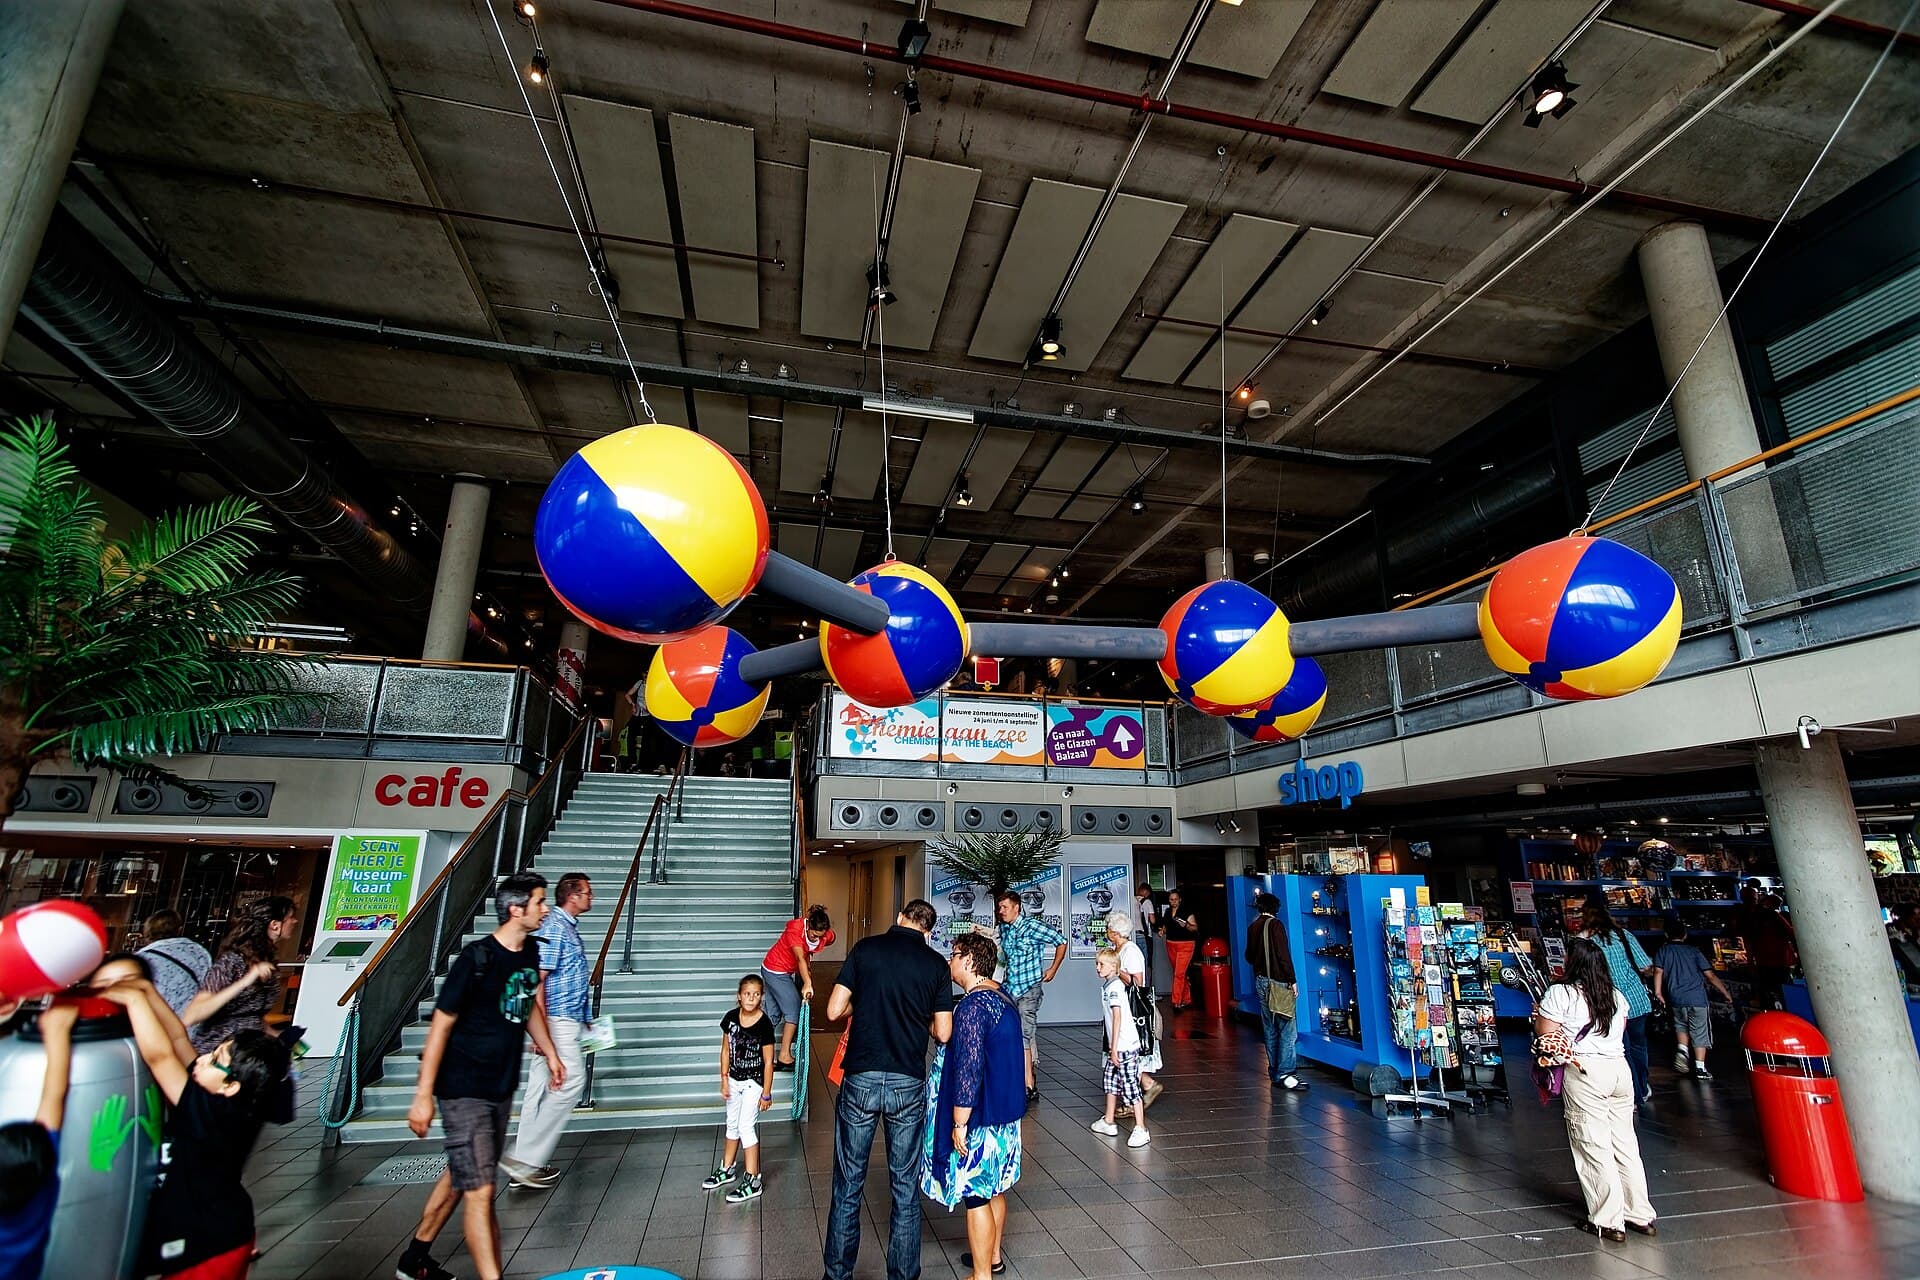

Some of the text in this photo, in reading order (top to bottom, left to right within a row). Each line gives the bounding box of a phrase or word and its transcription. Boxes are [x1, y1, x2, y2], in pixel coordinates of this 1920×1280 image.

[948, 708, 1039, 719] Nieuwe zomertentoonstelling!
[945, 727, 988, 741] aan
[994, 729, 1027, 742] zee
[1052, 729, 1085, 741] Ga naar
[952, 738, 962, 747] AT
[964, 739, 980, 748] THE
[982, 740, 1013, 749] BEACH
[1054, 738, 1096, 750] de Glazen
[1056, 749, 1088, 761] Balzaal
[375, 767, 488, 808] cafe
[1278, 758, 1364, 810] shop
[360, 841, 399, 852] SCAN
[349, 855, 404, 868] HIER JE
[341, 868, 408, 880] Museum-
[352, 881, 392, 893] kaart
